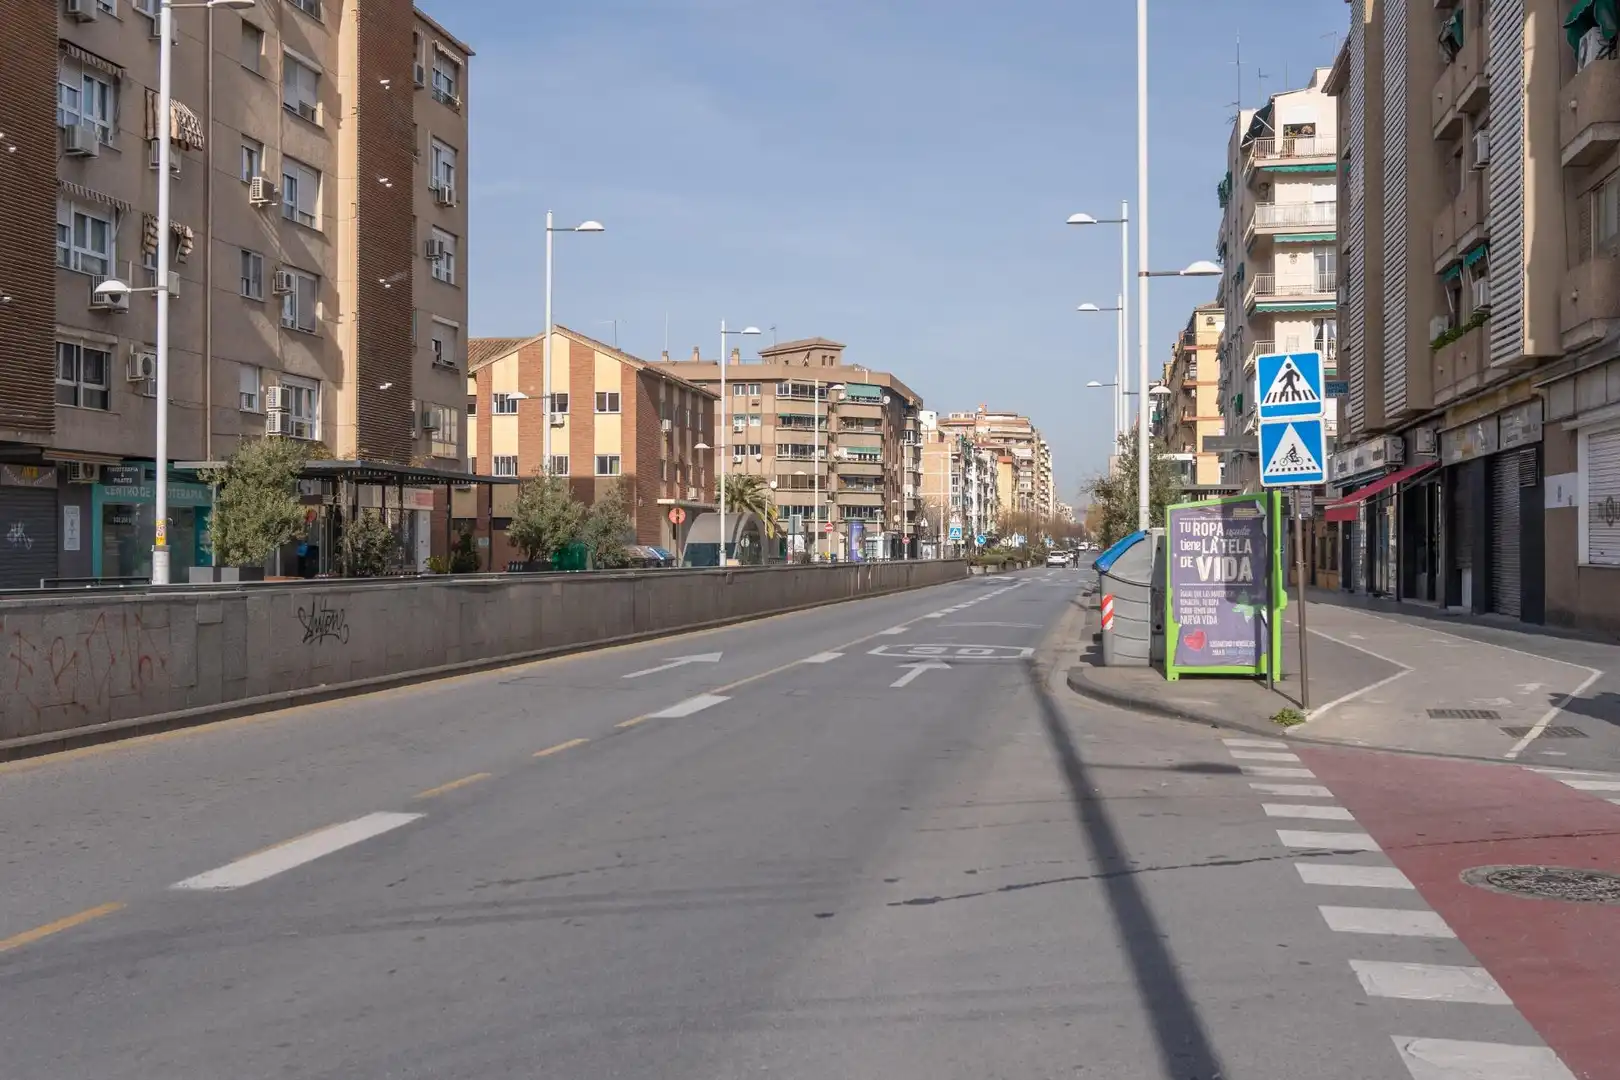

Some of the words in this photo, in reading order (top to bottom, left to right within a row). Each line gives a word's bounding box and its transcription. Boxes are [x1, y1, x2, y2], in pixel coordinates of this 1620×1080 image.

[104, 487, 139, 498] CENTRO
[139, 487, 151, 498] DE
[1179, 522, 1192, 533] TU
[1192, 520, 1224, 537] ROPA
[1180, 538, 1201, 551] tiene
[1201, 538, 1219, 554] LA
[1220, 538, 1253, 554] TELA
[1180, 556, 1194, 568] DE
[1196, 556, 1254, 582] VIDA
[1180, 615, 1200, 625] NUEVA
[1201, 615, 1218, 625] VIDA
